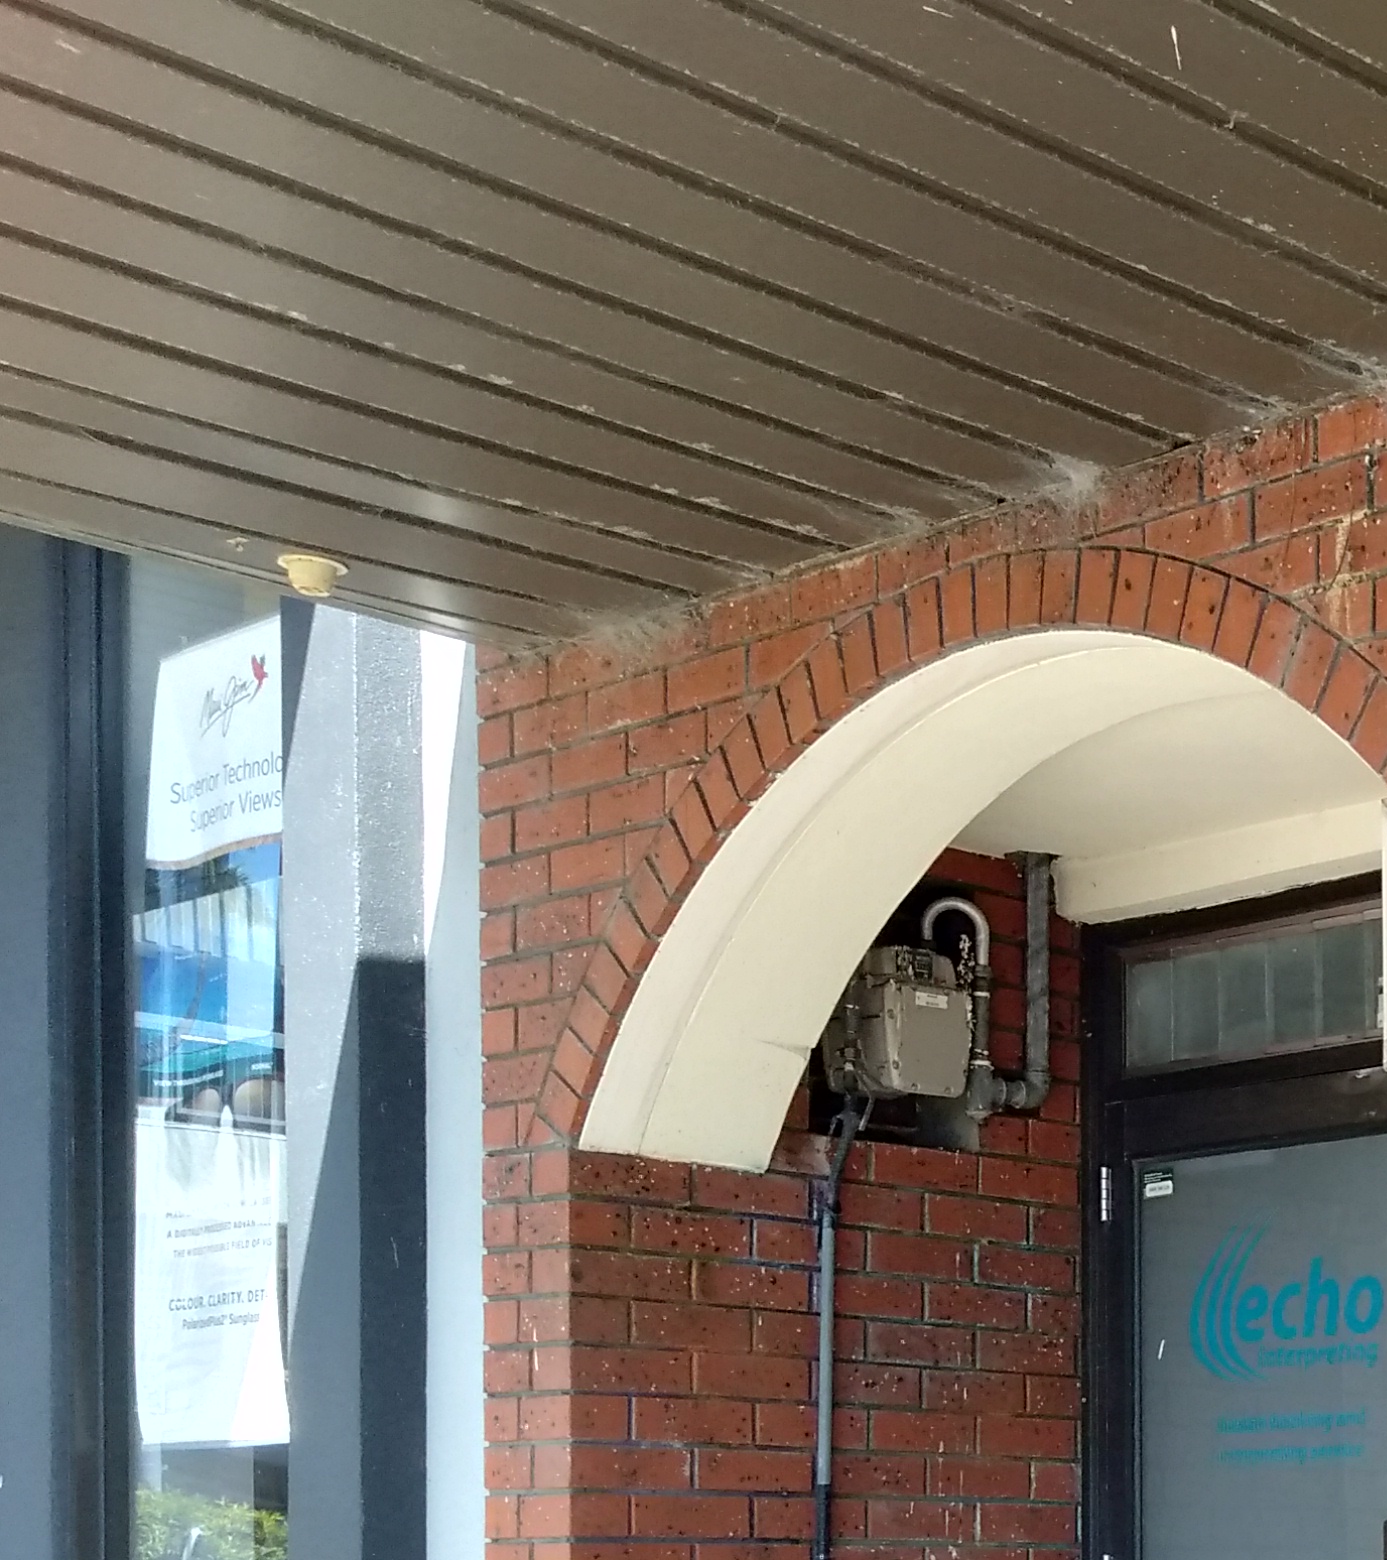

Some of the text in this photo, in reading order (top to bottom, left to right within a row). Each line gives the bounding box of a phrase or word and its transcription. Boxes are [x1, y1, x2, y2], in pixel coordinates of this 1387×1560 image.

[169, 770, 220, 805] Superior
[190, 788, 283, 833] Superior Views
[247, 1289, 268, 1303] DET
[1235, 1256, 1384, 1343] echo
